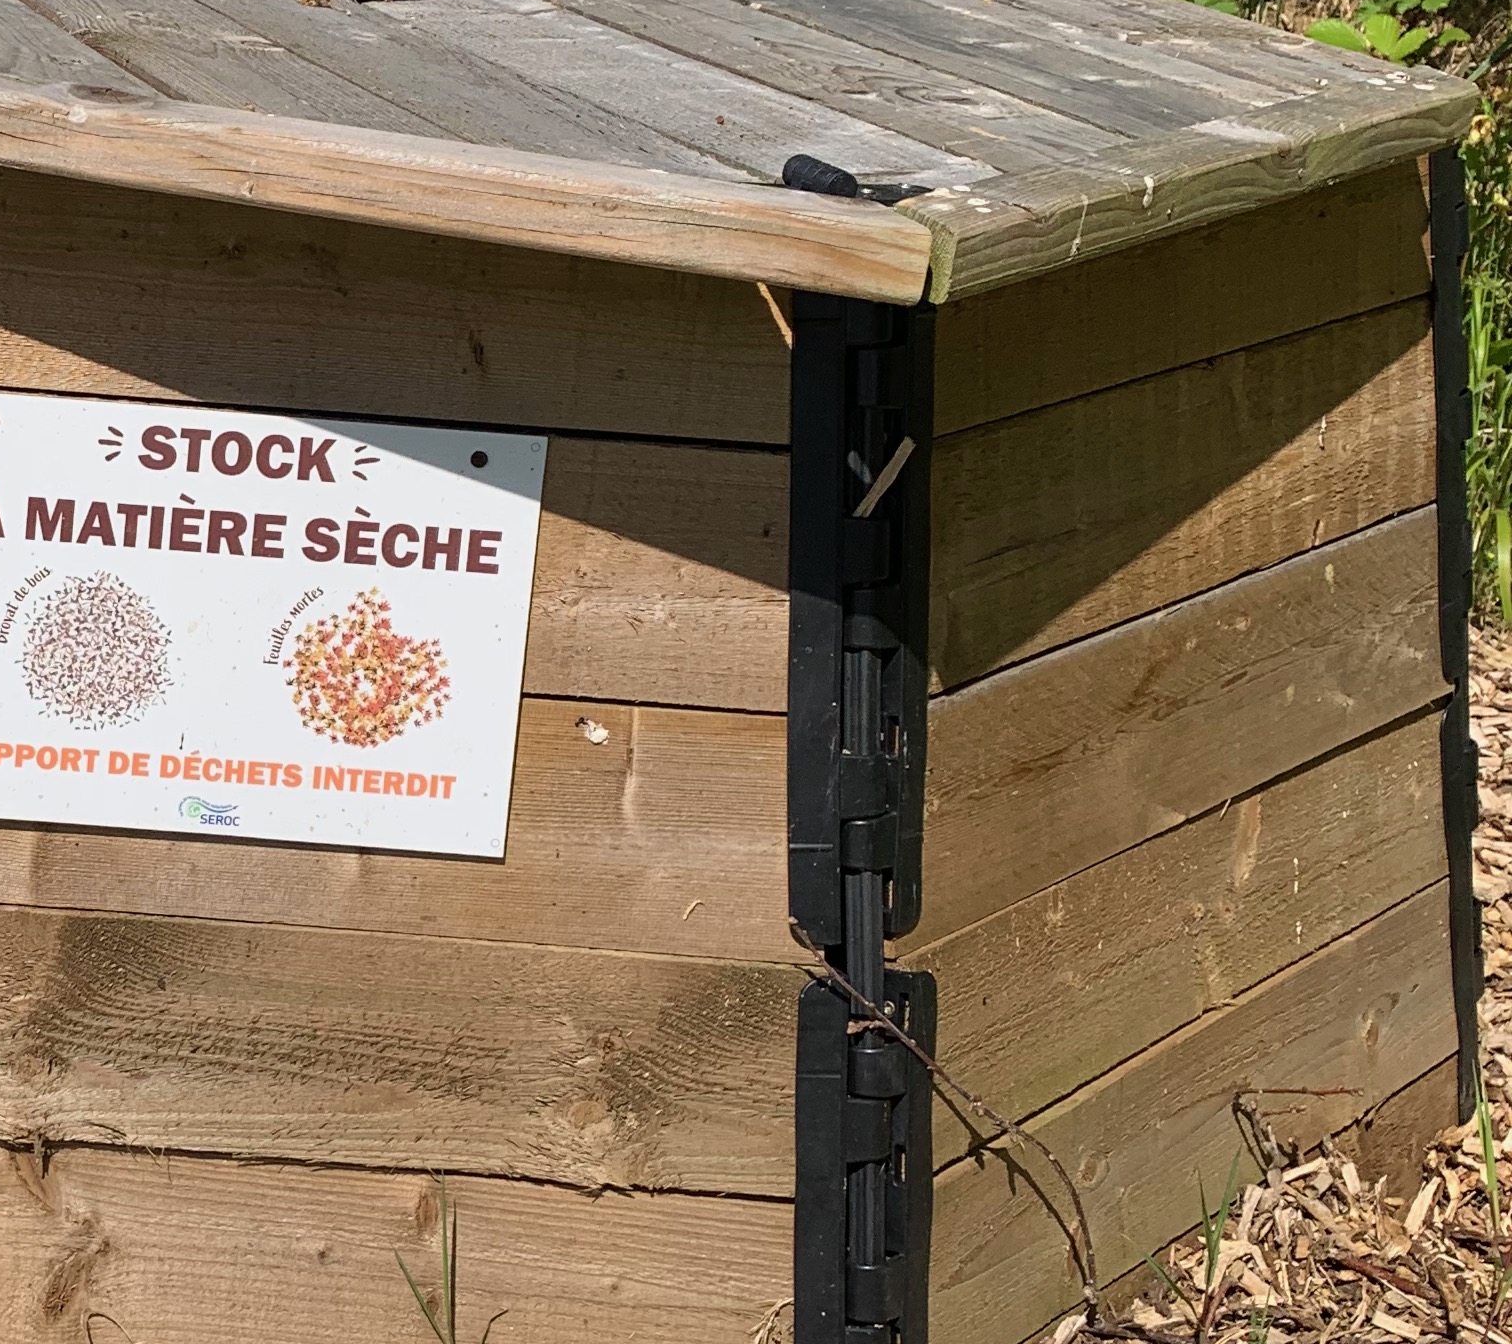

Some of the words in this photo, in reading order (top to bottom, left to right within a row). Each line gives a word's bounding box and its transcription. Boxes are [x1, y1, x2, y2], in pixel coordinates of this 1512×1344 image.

[137, 424, 336, 483] STOCK
[24, 493, 288, 559] MATIÈRE
[300, 506, 503, 575] SÈCHE
[13, 586, 30, 602] de
[24, 565, 51, 588] bois
[263, 618, 293, 665] Feuilles
[107, 751, 150, 777] DE
[159, 751, 303, 788] DÉCHETS
[312, 765, 457, 800] INTERDIT
[199, 813, 241, 827] SEROC
